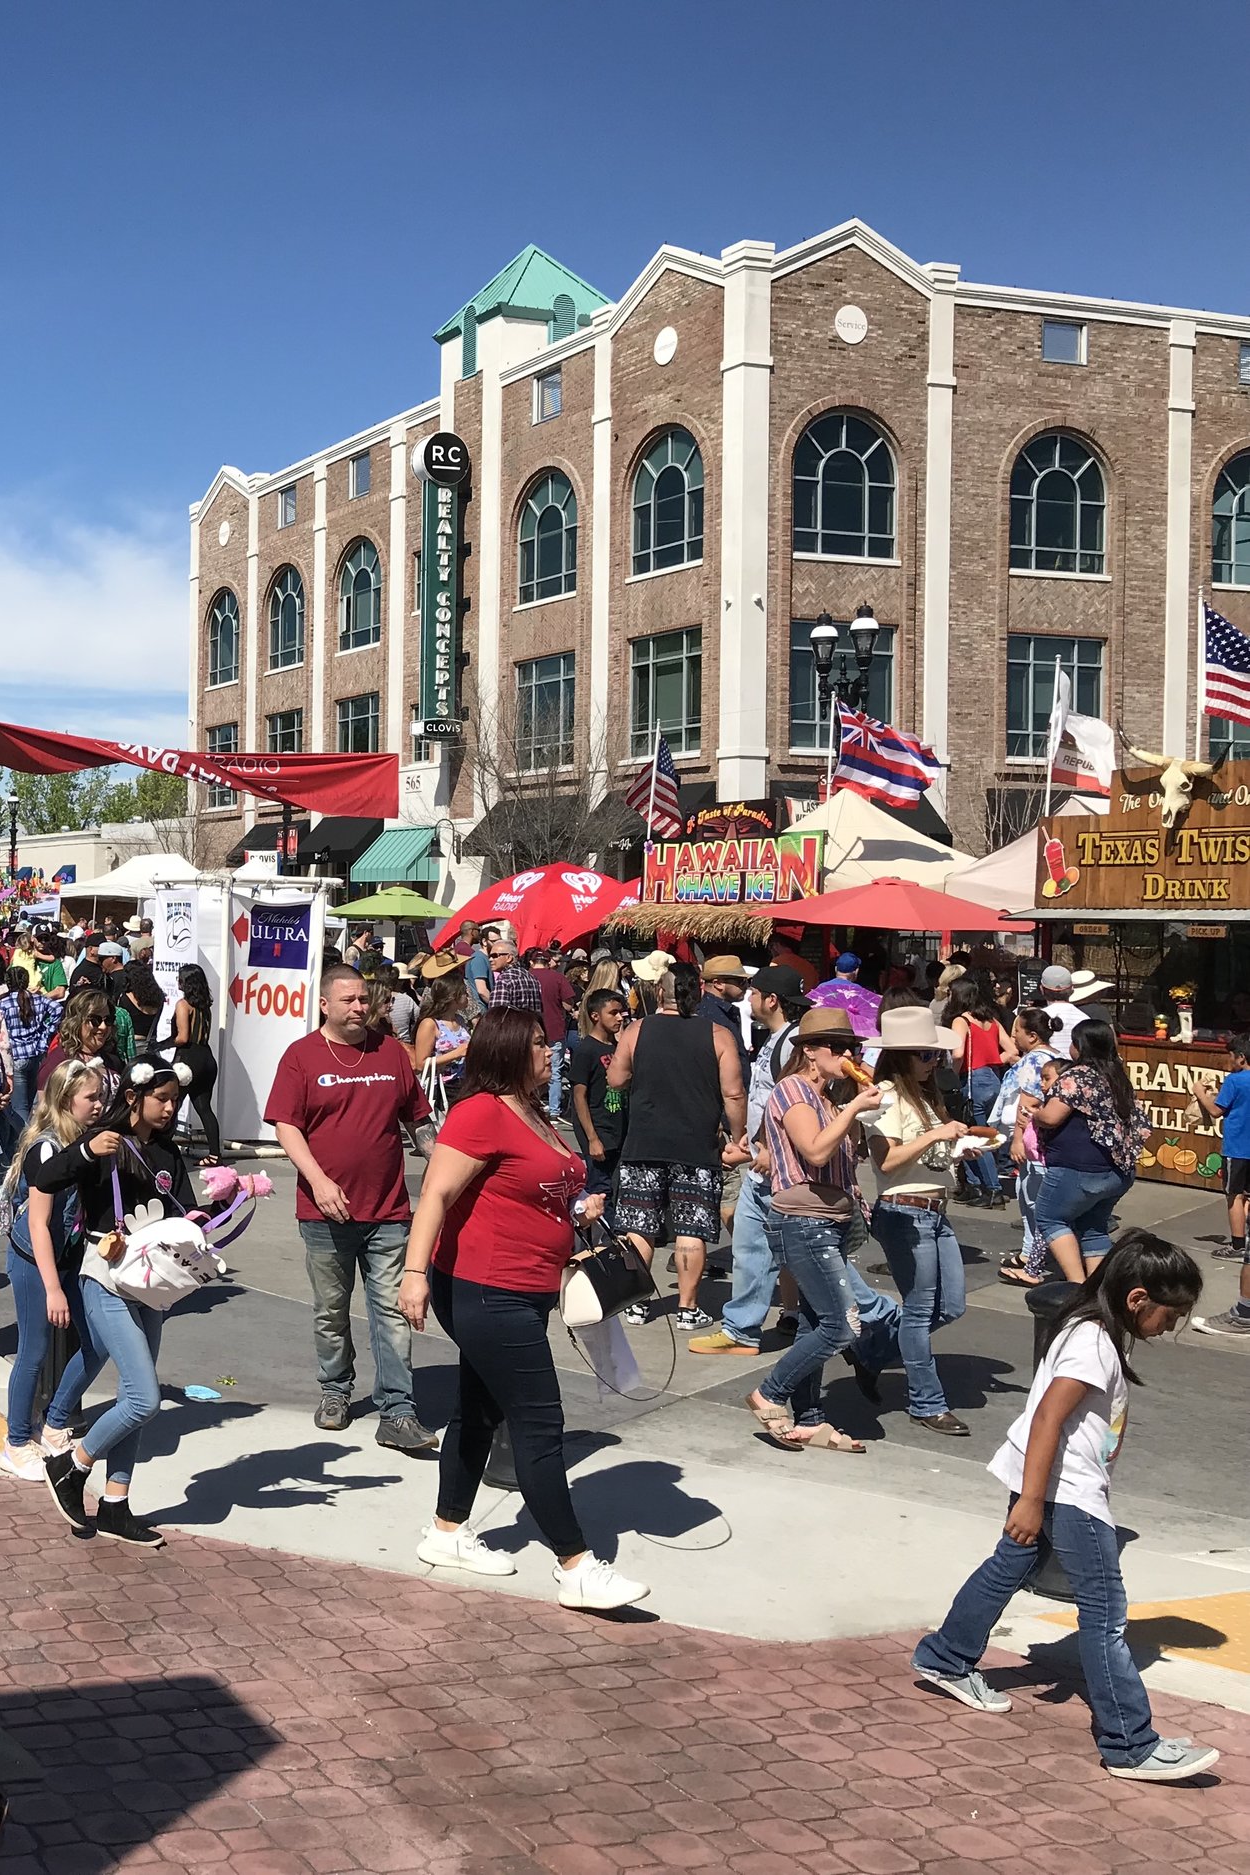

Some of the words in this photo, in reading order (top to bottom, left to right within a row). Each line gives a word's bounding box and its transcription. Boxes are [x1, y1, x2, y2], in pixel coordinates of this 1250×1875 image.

[837, 318, 868, 331] Service
[432, 445, 461, 463] RC
[436, 487, 453, 582] REALTY
[435, 591, 453, 717] CONCEPTS
[426, 723, 461, 733] CLOVIS
[405, 775, 421, 791] 565
[1119, 794, 1141, 813] The
[697, 809, 722, 825] Taste
[723, 804, 733, 816] of
[733, 802, 773, 829] Paradise
[1077, 831, 1160, 866] TEXAS
[644, 835, 820, 902] HAWAIIAN
[676, 873, 740, 901] SHAVE
[746, 872, 775, 900] ICE
[1142, 872, 1230, 901] DRINK
[496, 893, 524, 903] iHeart
[491, 903, 519, 912] RADIO
[256, 912, 300, 925] Michelob
[251, 924, 309, 942] ULTRA
[1210, 928, 1221, 936] UP
[244, 971, 306, 1018] Food
[317, 1072, 396, 1087] Champion
